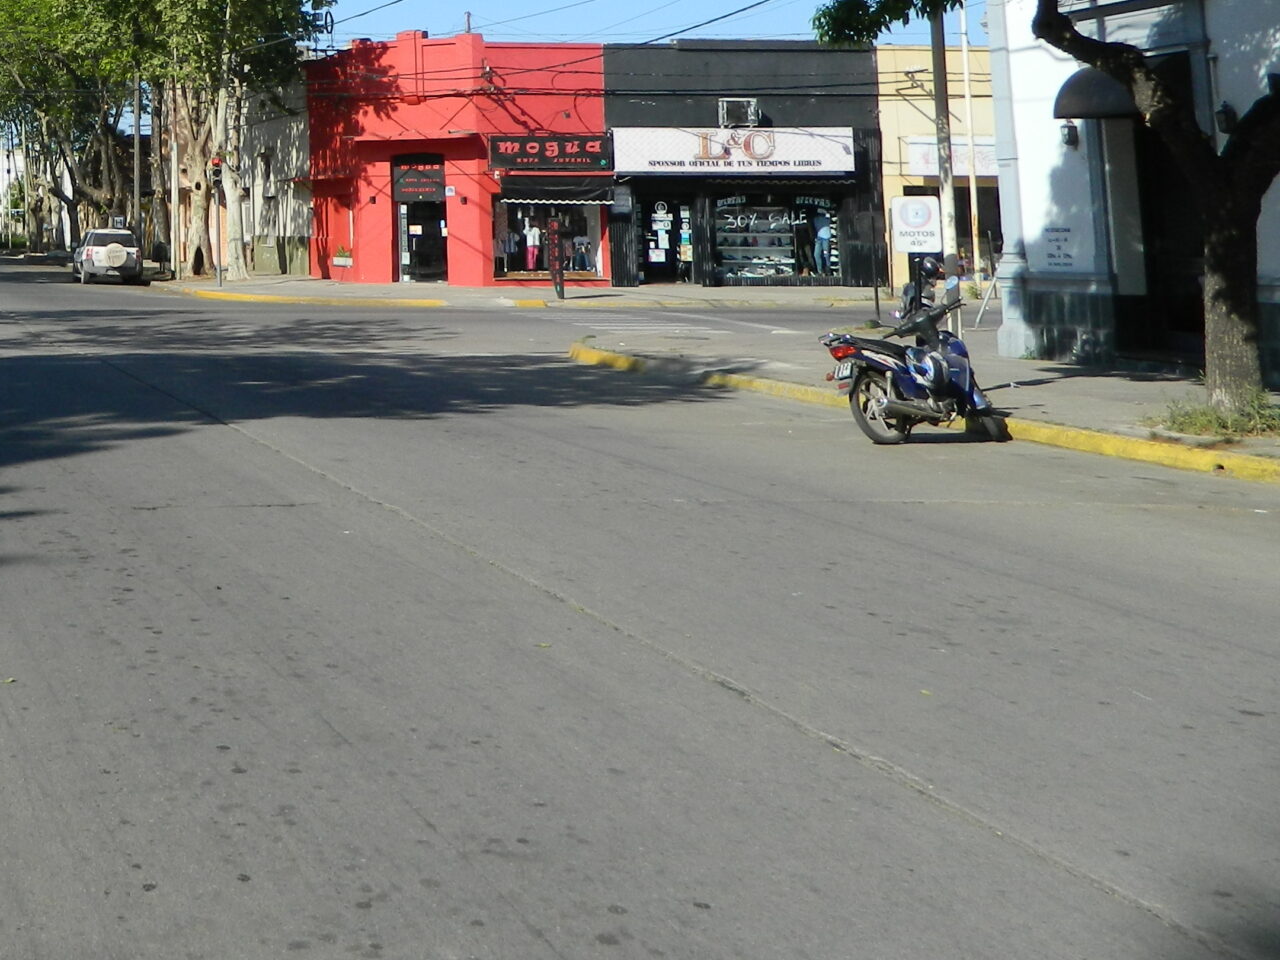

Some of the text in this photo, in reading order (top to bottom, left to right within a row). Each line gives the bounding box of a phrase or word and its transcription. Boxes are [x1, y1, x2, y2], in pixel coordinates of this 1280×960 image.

[723, 210, 807, 229] 30% SALE
[899, 230, 935, 238] MOTOS
